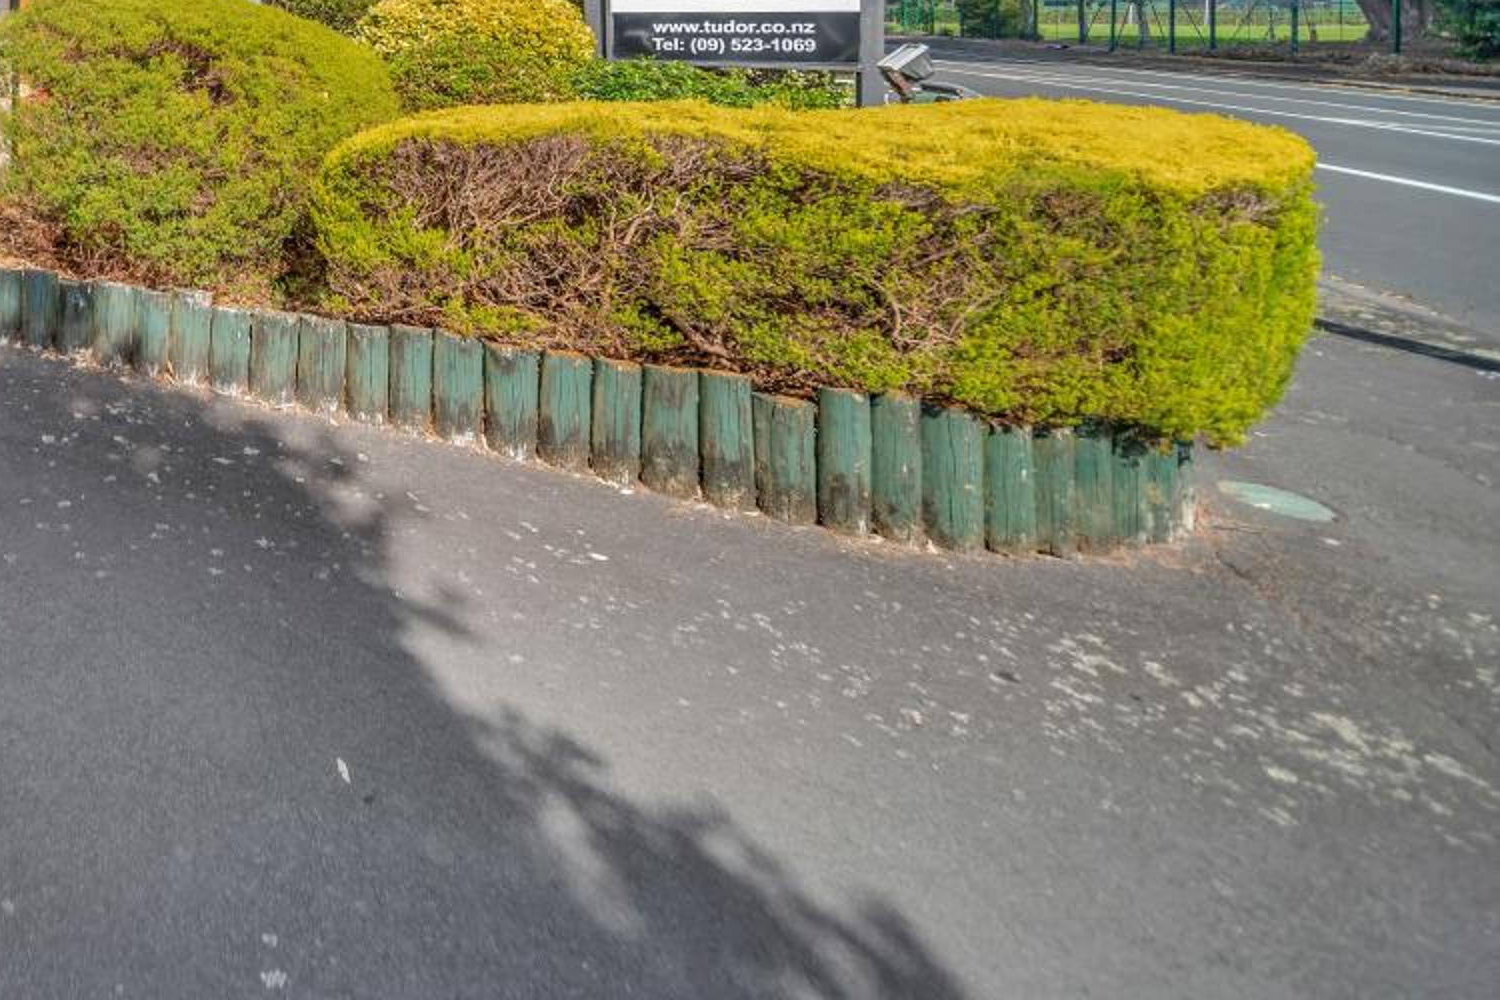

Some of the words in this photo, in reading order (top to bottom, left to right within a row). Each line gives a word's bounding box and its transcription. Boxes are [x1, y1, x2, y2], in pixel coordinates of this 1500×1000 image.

[652, 19, 816, 34] www.tudor.co.nz
[651, 37, 685, 51] Tel:
[690, 37, 725, 54] (09)
[731, 37, 816, 52] 523-1069
